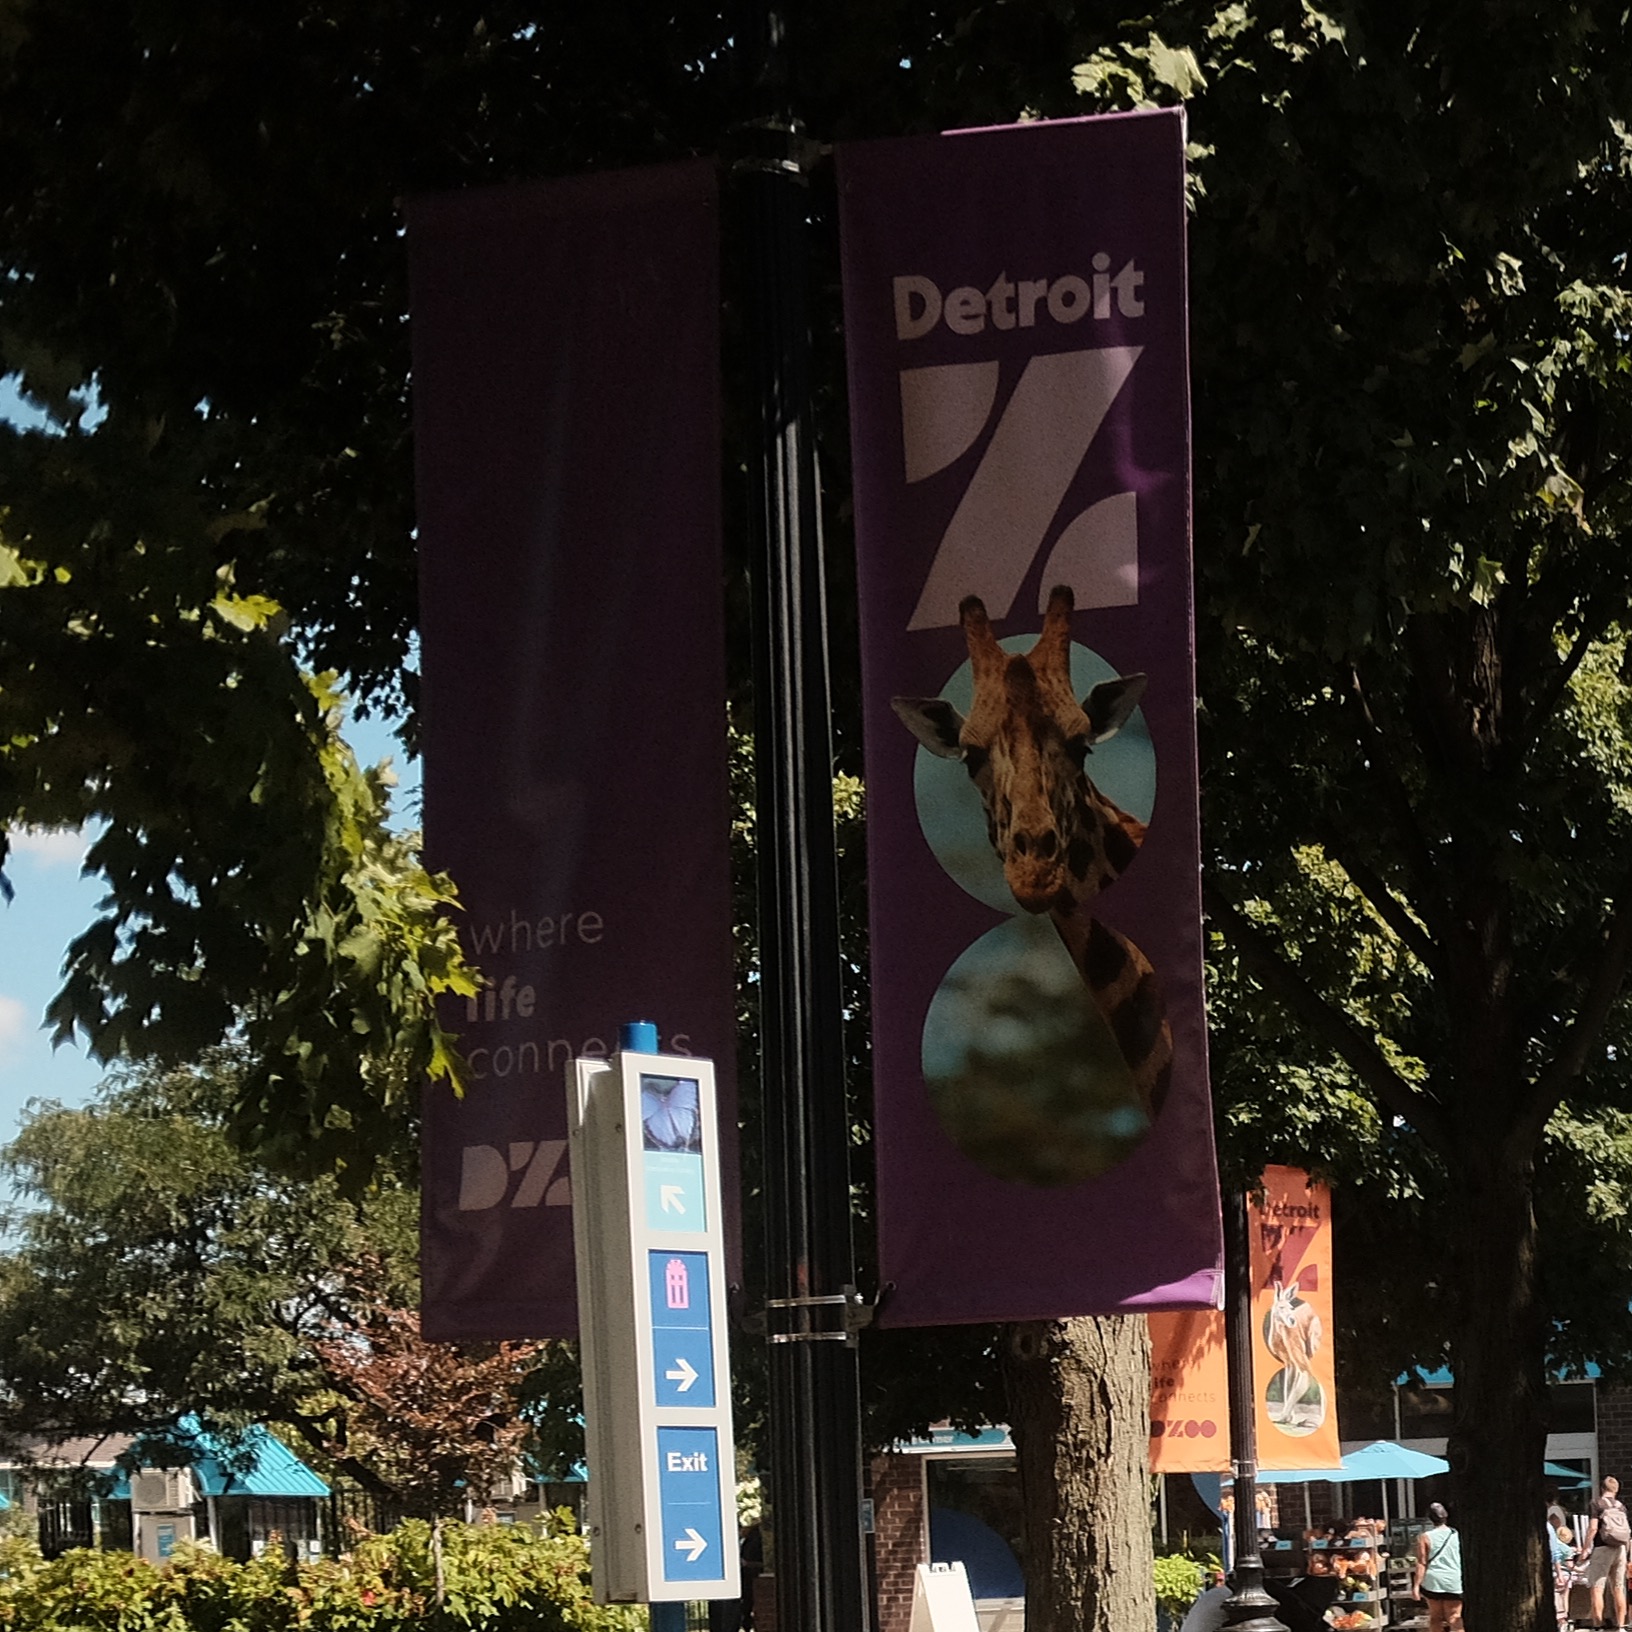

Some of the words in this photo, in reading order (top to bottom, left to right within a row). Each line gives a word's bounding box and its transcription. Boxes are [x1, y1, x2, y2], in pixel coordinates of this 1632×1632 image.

[893, 252, 1145, 340] Detroit
[470, 909, 604, 955] where
[467, 1033, 692, 1079] connes
[667, 1452, 708, 1472] Exit
